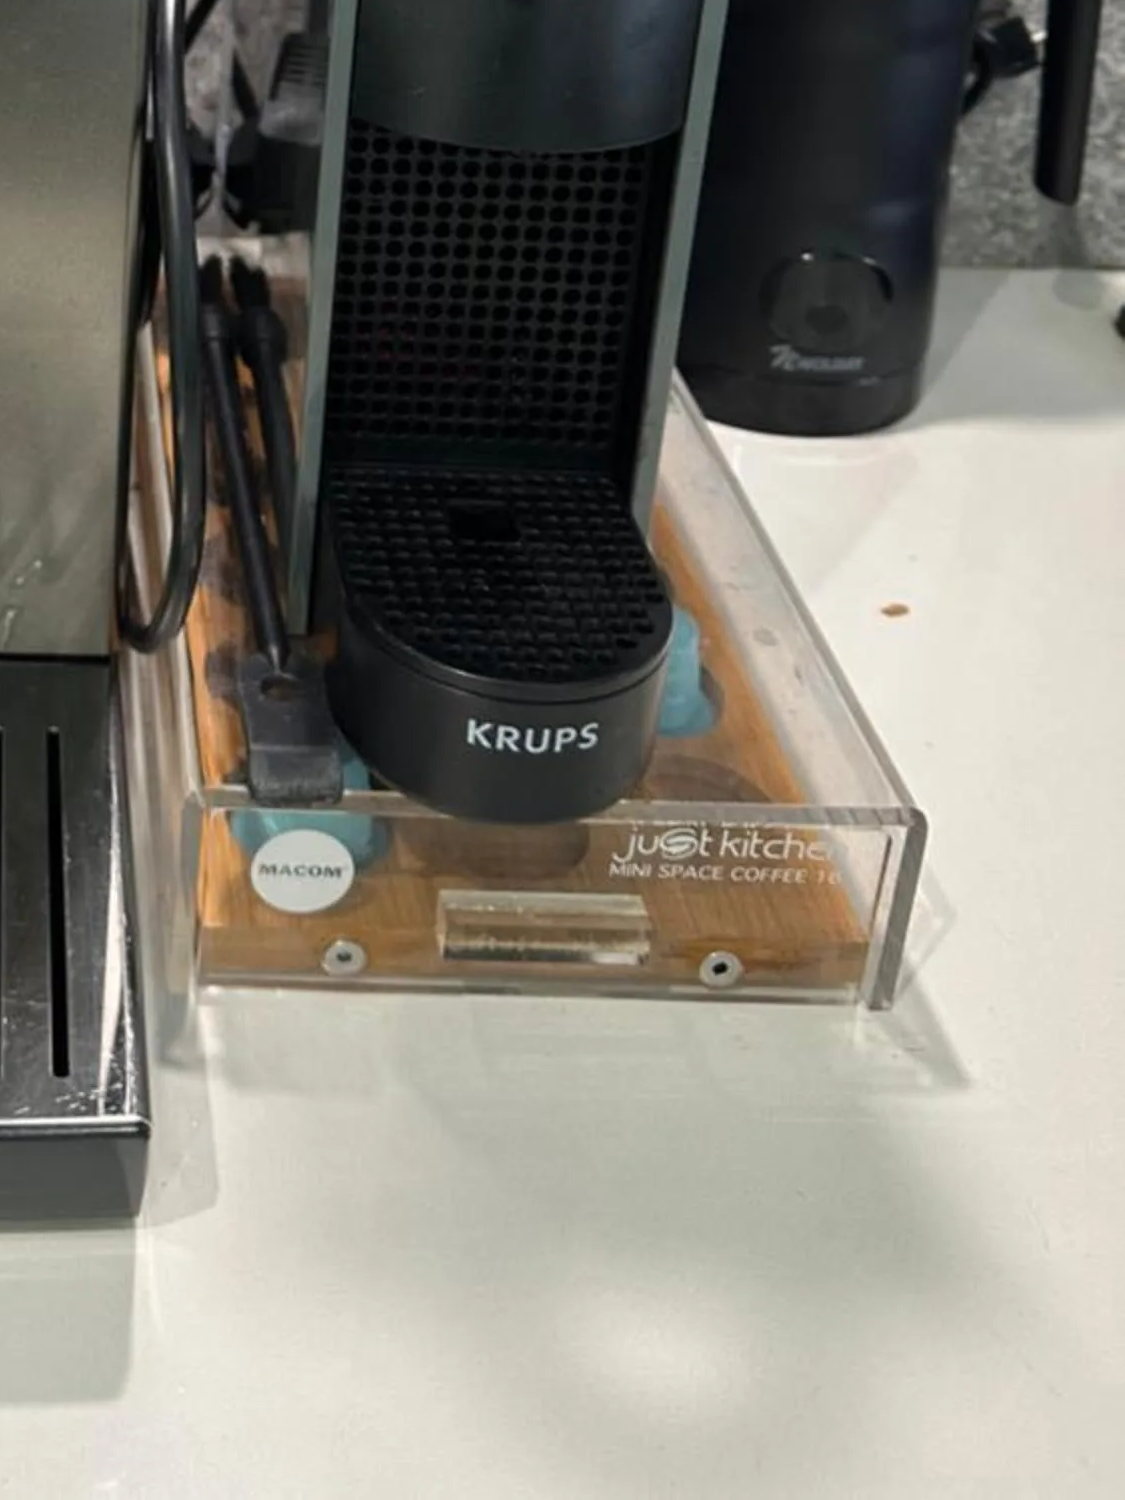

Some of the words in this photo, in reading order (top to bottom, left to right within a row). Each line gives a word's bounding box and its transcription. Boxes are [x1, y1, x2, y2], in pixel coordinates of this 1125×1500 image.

[467, 717, 600, 754] KRUPS
[719, 828, 832, 862] kitche
[258, 863, 343, 879] MACOM
[609, 862, 653, 878] MINI
[658, 864, 724, 882] SPACE
[730, 866, 807, 884] COFFEE
